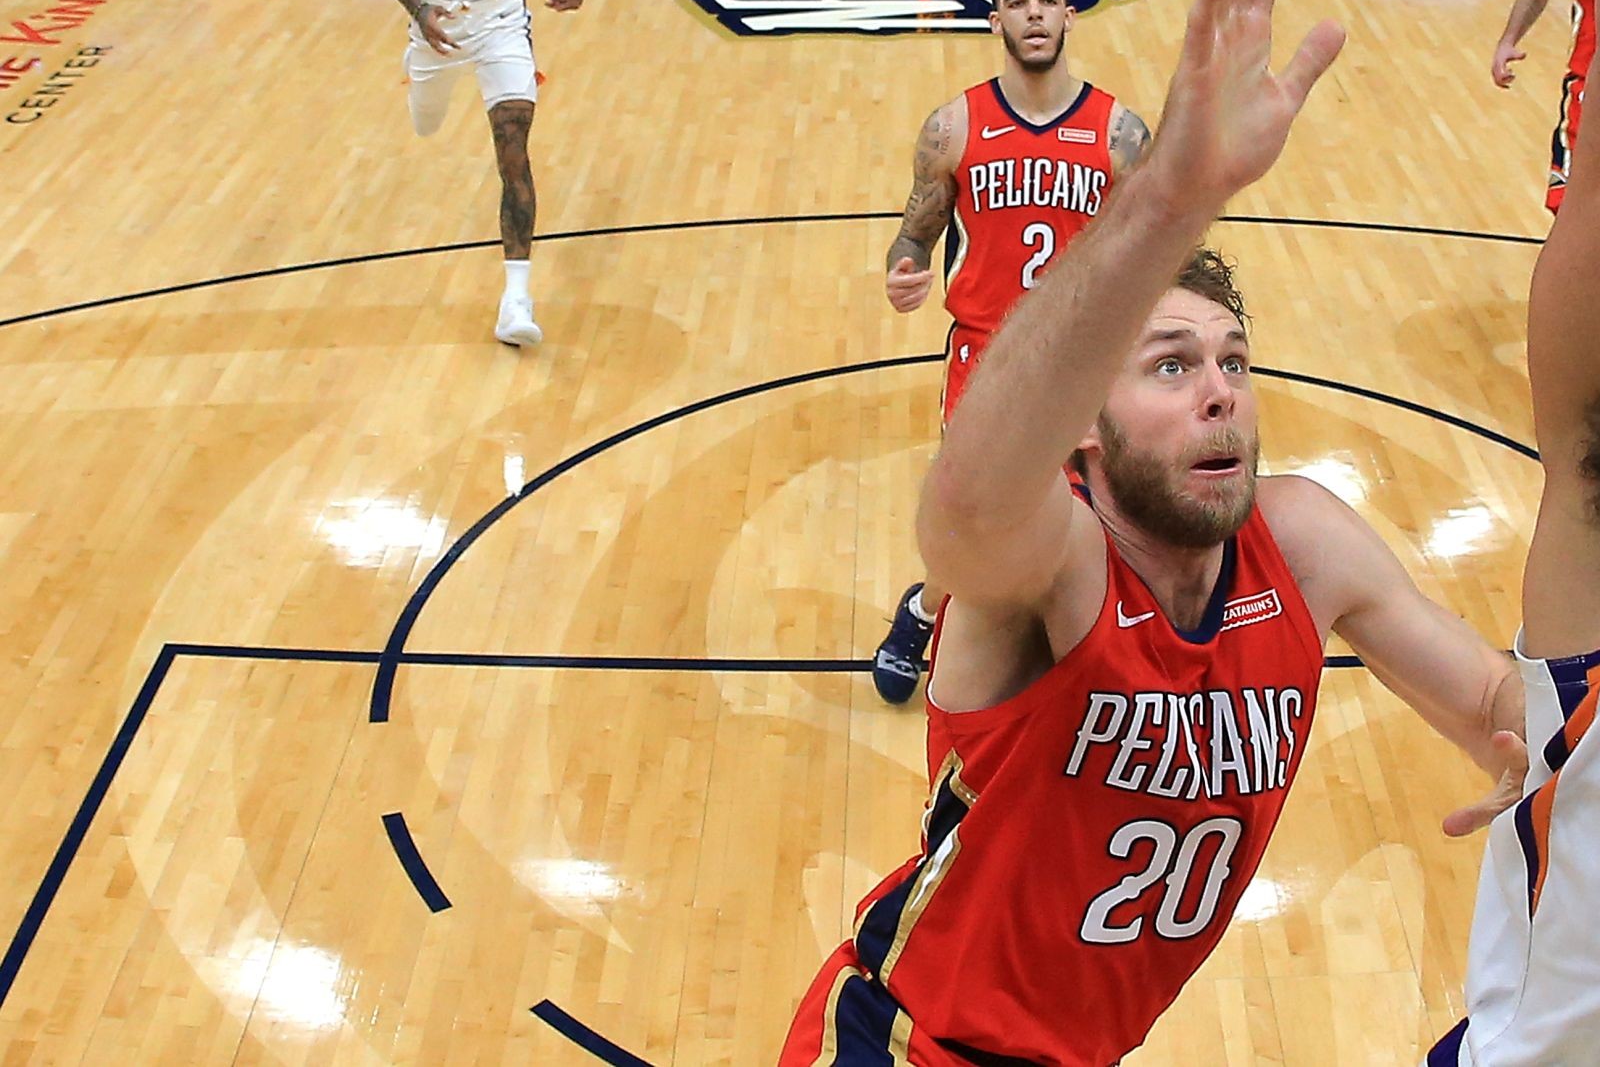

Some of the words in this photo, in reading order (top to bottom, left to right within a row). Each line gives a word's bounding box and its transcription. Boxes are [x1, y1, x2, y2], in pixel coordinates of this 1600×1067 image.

[6, 45, 113, 124] CENTER
[969, 157, 1107, 217] PELICANS
[1020, 222, 1056, 290] 2
[1080, 817, 1243, 944] 20
